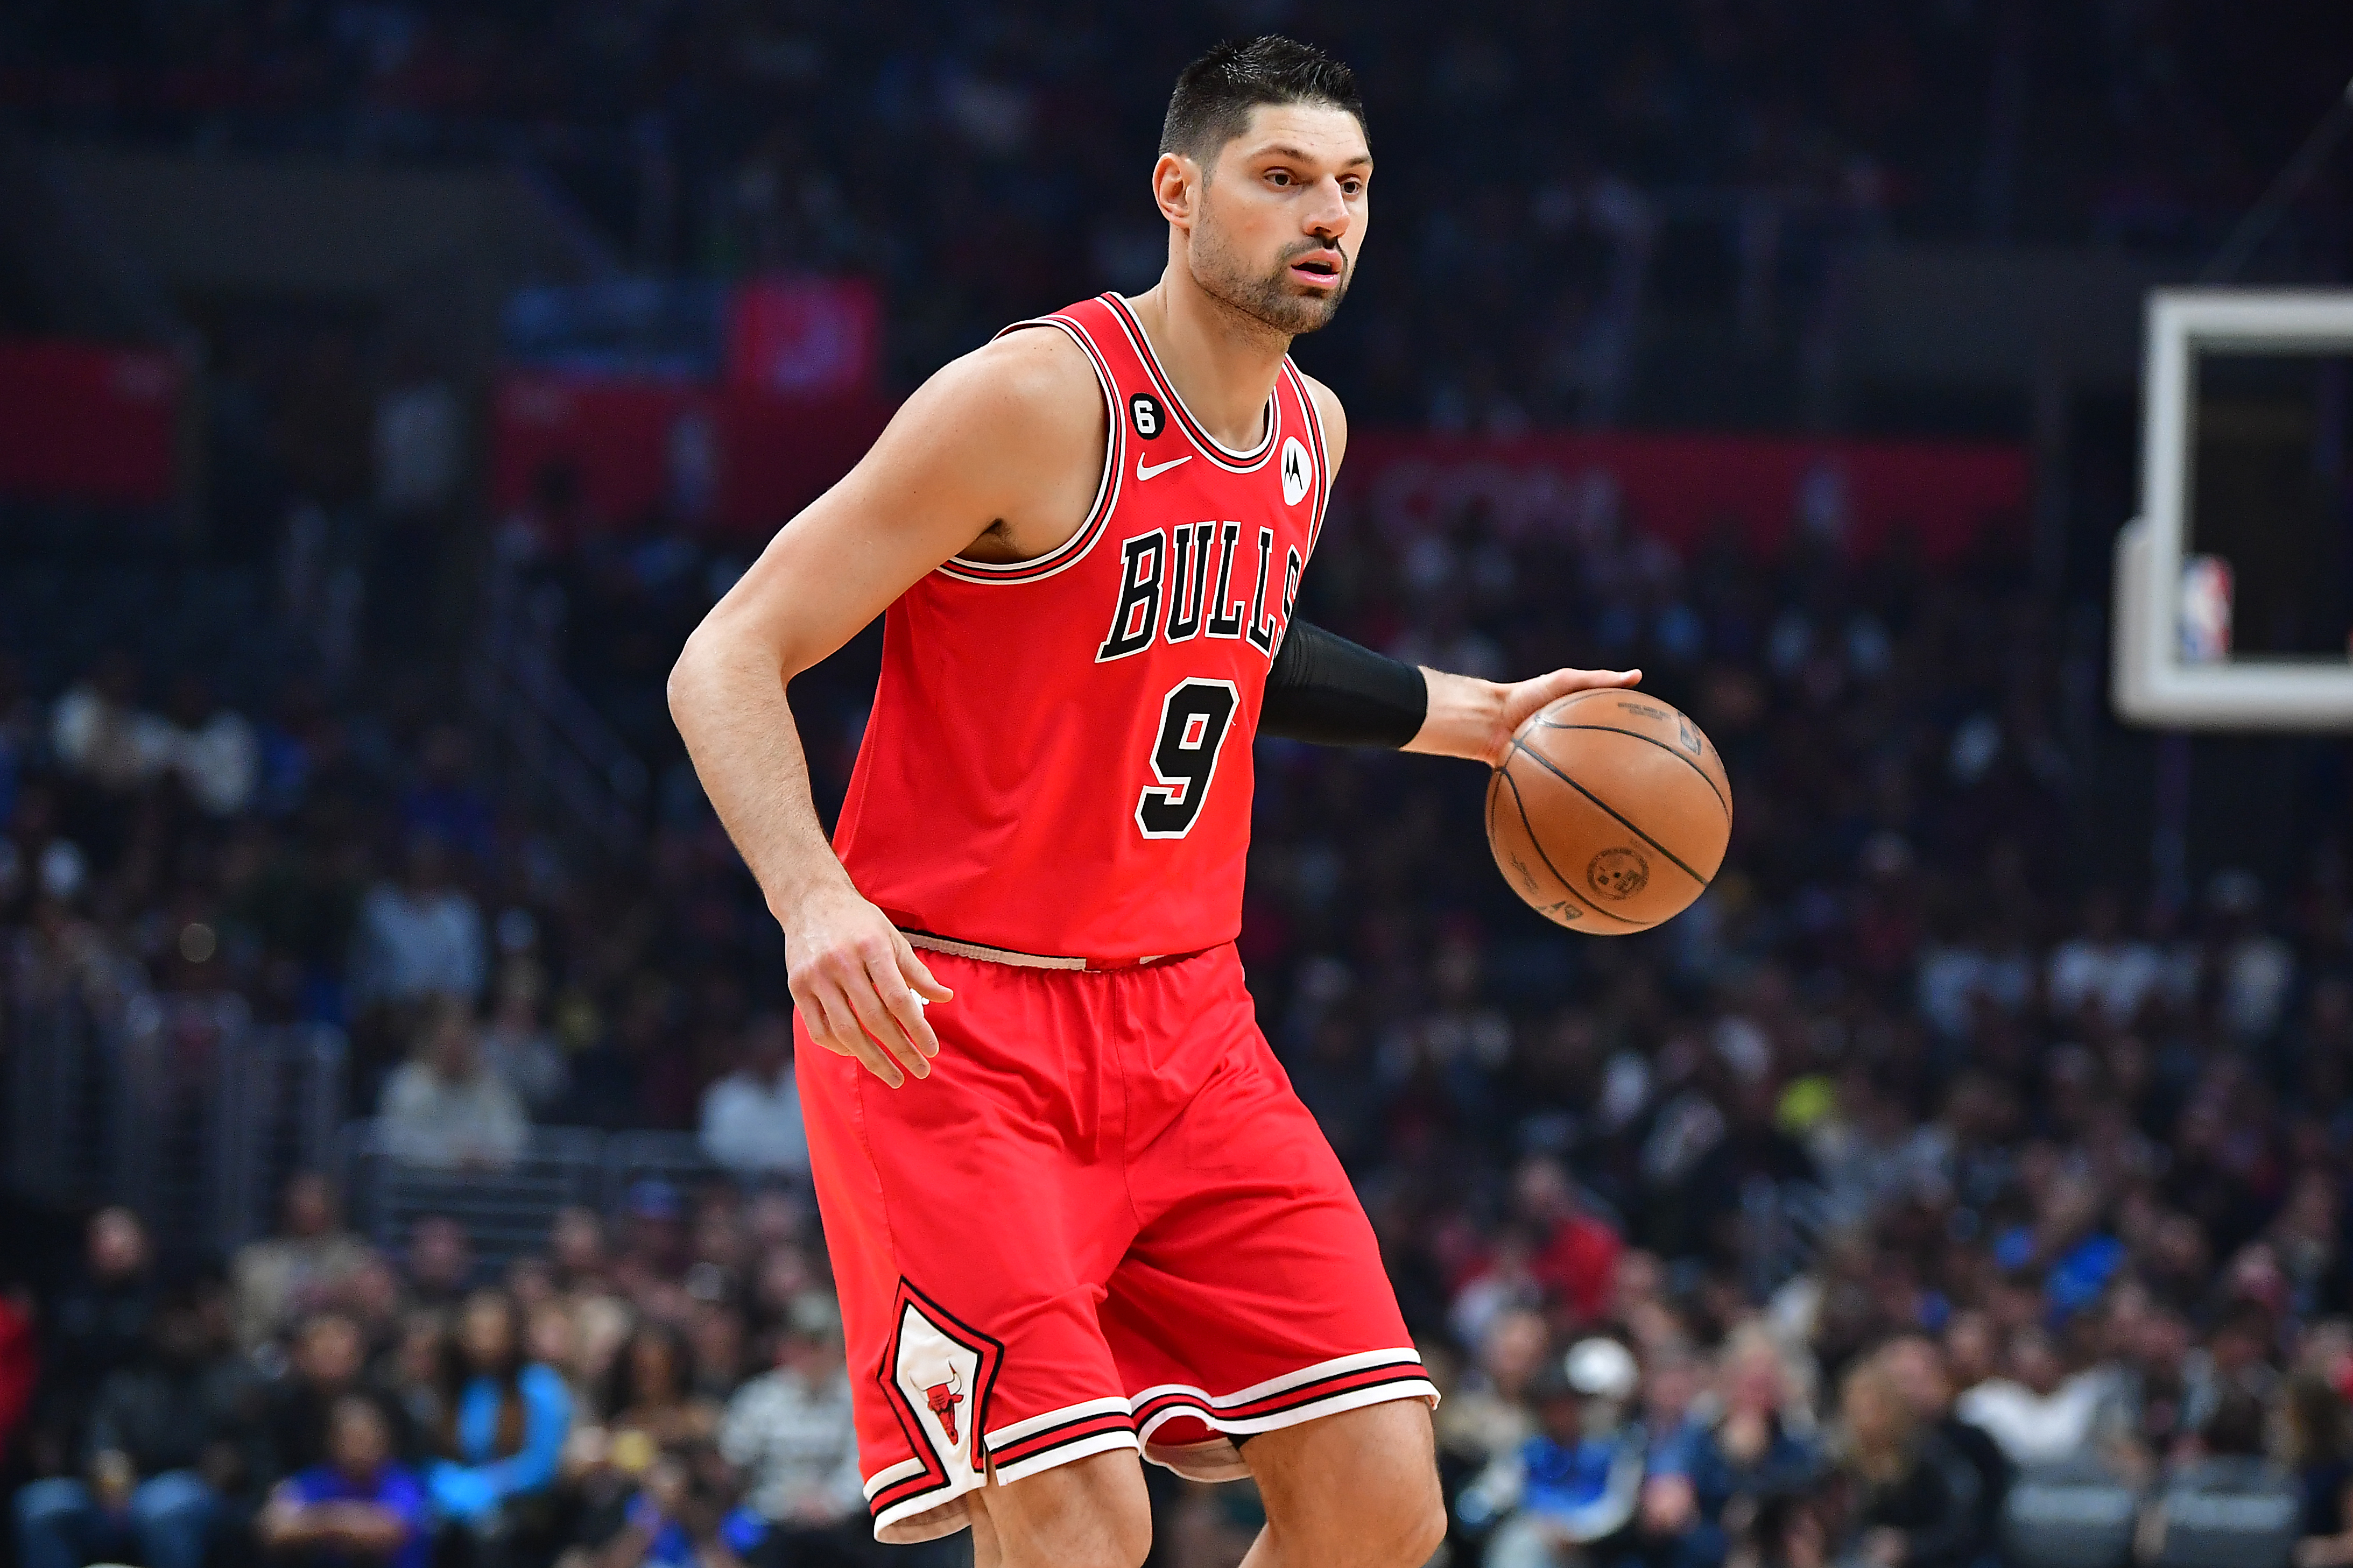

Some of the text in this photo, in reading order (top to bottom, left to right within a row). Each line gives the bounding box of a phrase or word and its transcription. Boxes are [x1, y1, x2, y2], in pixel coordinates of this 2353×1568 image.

[1134, 400, 1156, 434] 6
[1094, 520, 1302, 676] BULLS
[1134, 676, 1240, 839] 9
